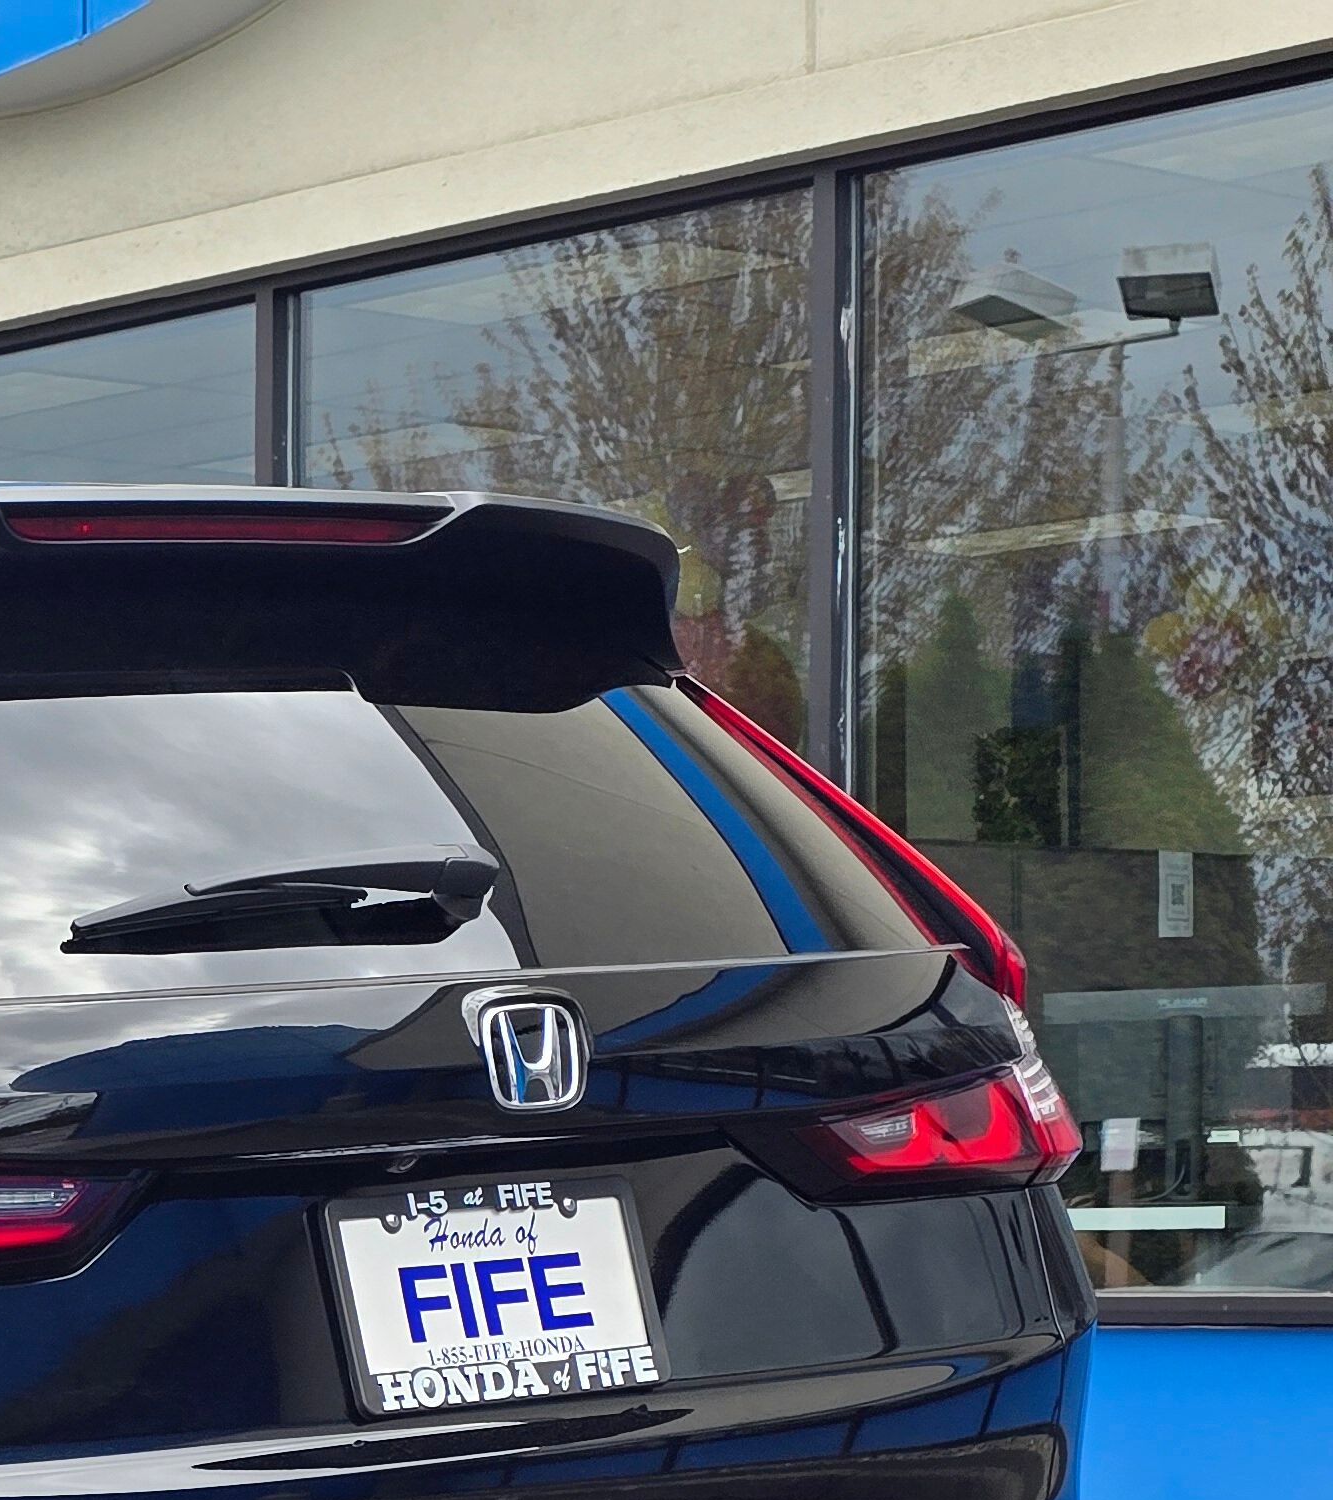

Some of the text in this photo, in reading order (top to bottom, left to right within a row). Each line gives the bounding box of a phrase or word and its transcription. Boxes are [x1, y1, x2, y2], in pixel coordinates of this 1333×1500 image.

[406, 1182, 555, 1217] I-5 at FIFE
[423, 1212, 539, 1255] Honda of
[398, 1252, 595, 1343] FIFE
[427, 1334, 586, 1366] 1-855-FIFE-HONDA
[377, 1345, 660, 1411] HONDA of FIFE
